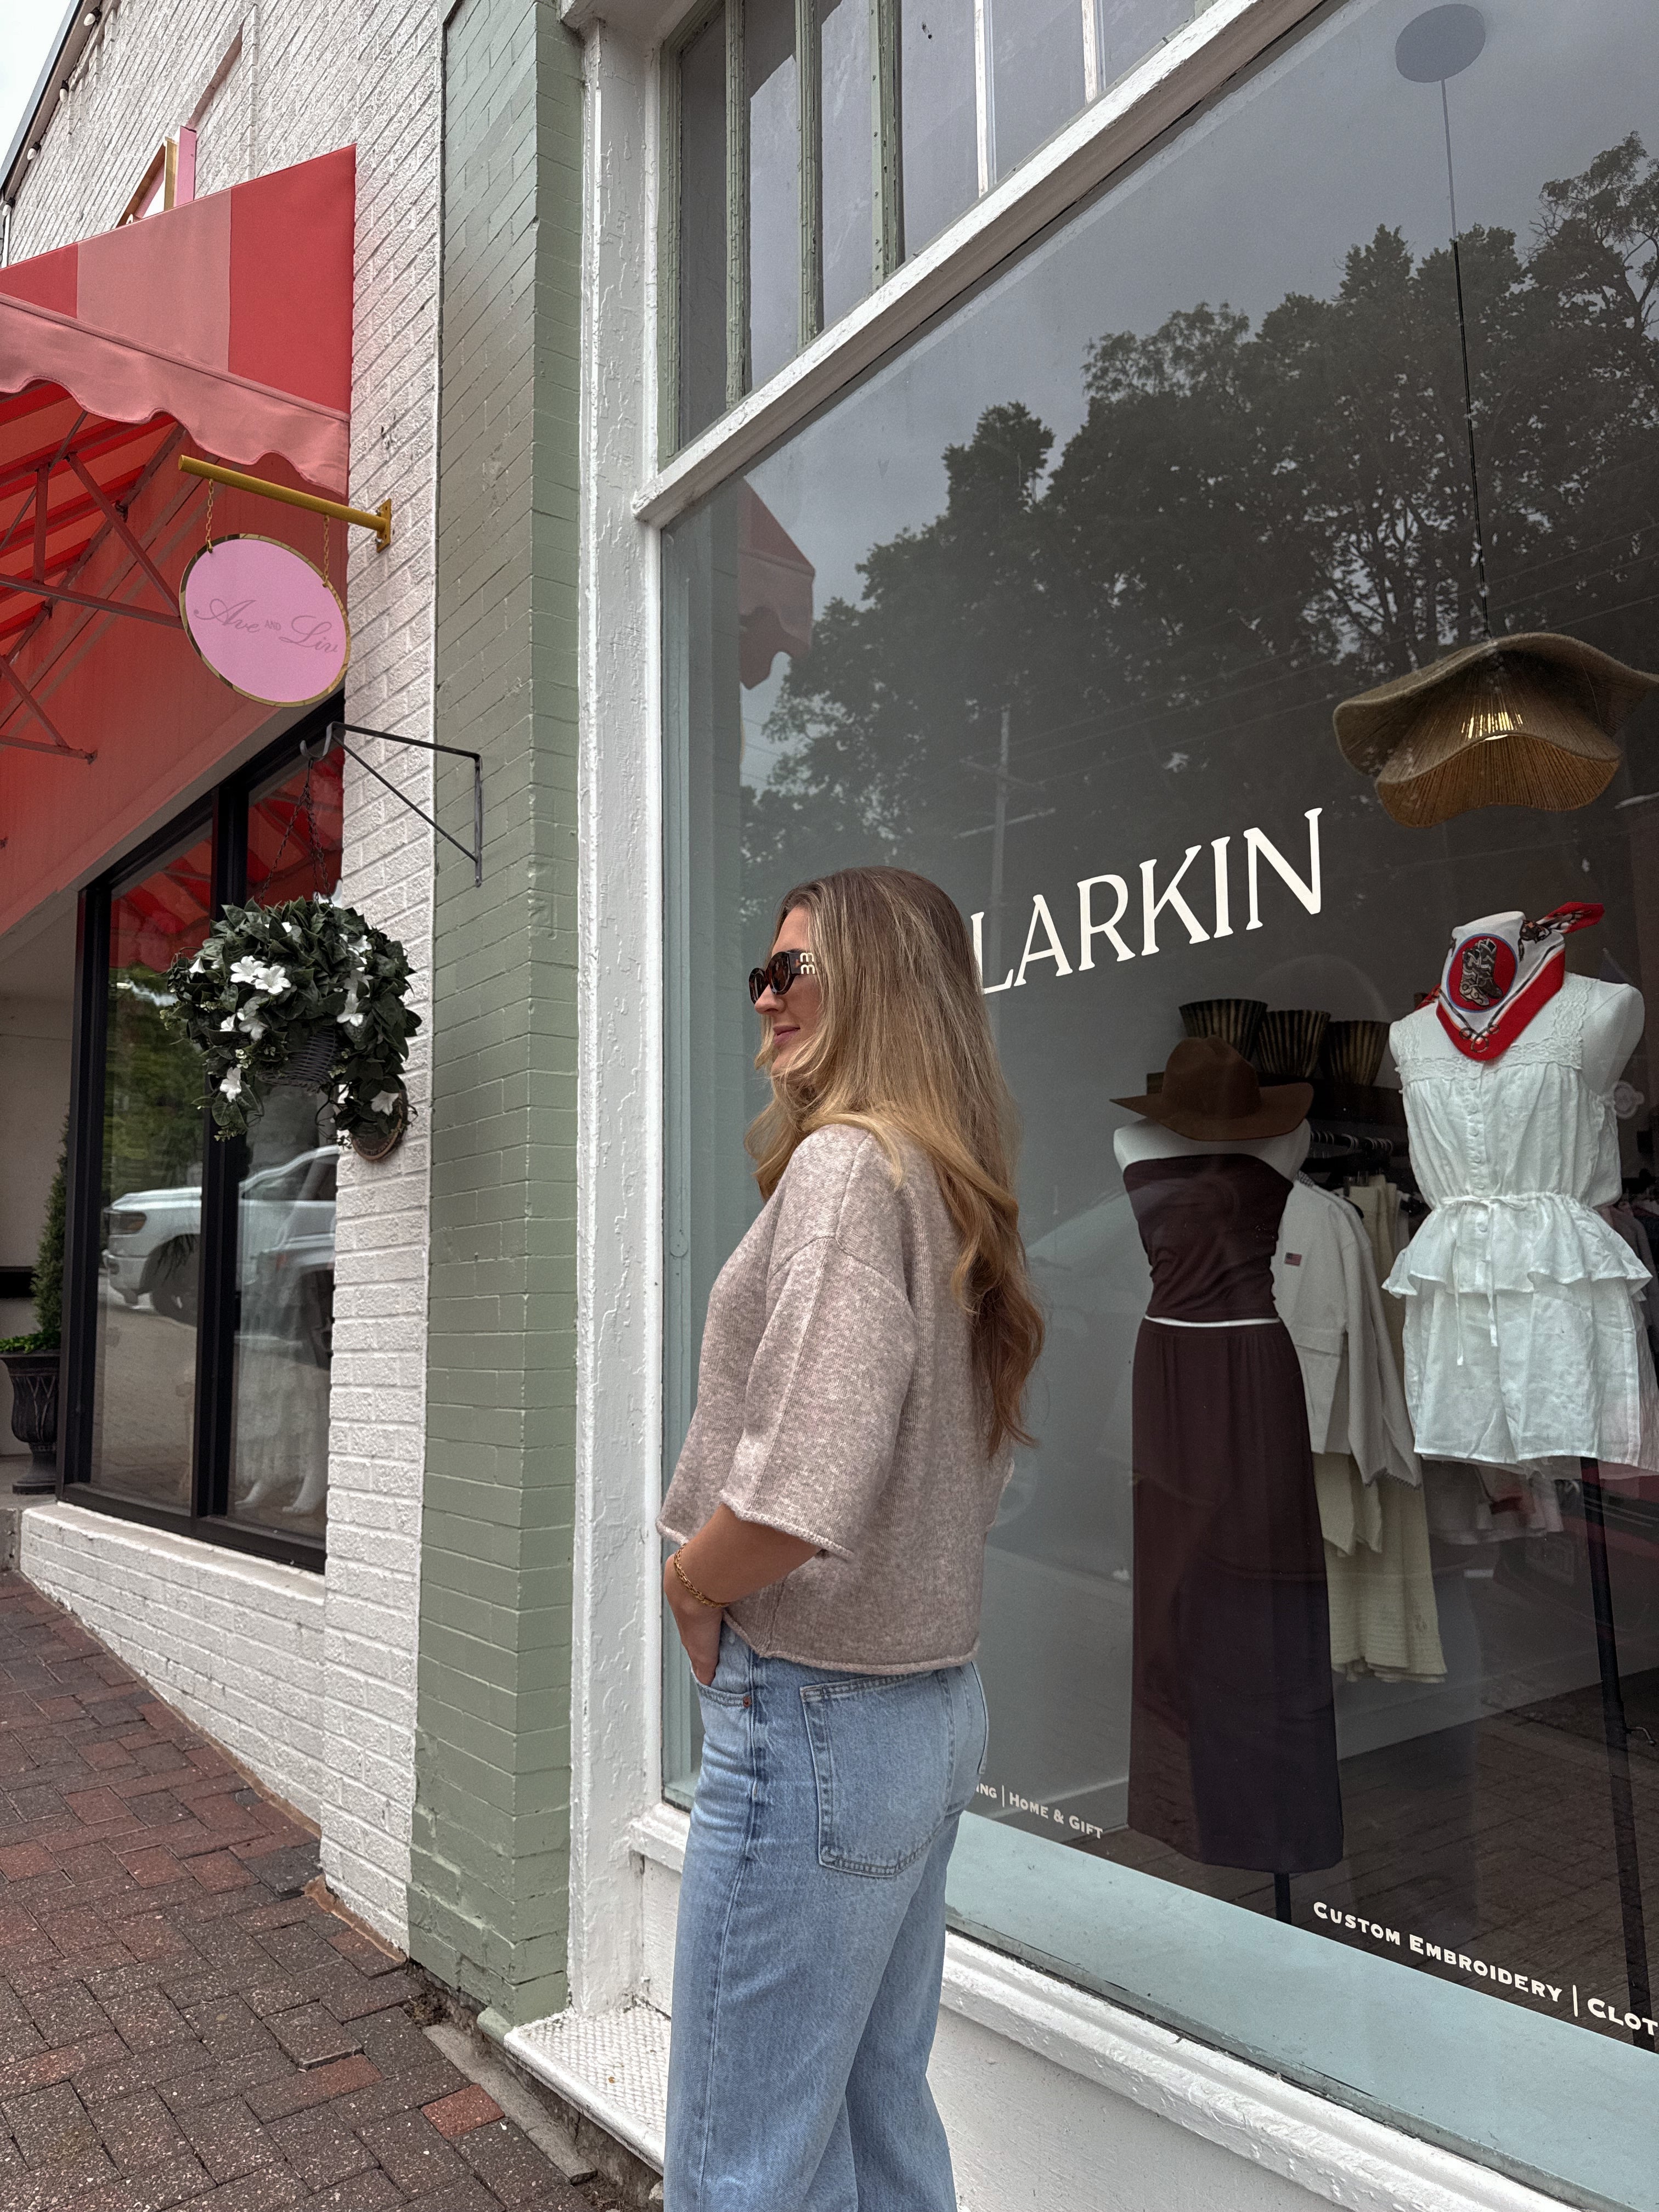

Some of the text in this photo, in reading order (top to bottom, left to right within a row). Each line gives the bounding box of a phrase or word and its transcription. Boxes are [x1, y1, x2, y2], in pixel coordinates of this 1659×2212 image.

[193, 598, 338, 653] Ave AND Liv
[970, 808, 1323, 995] LARKIN
[1009, 1791, 1048, 1819] HOME
[1053, 1809, 1064, 1825] &
[1069, 1815, 1103, 1839] GIFT
[1313, 1901, 1658, 2036] CUSTOM EMBROIDERY CLOT
